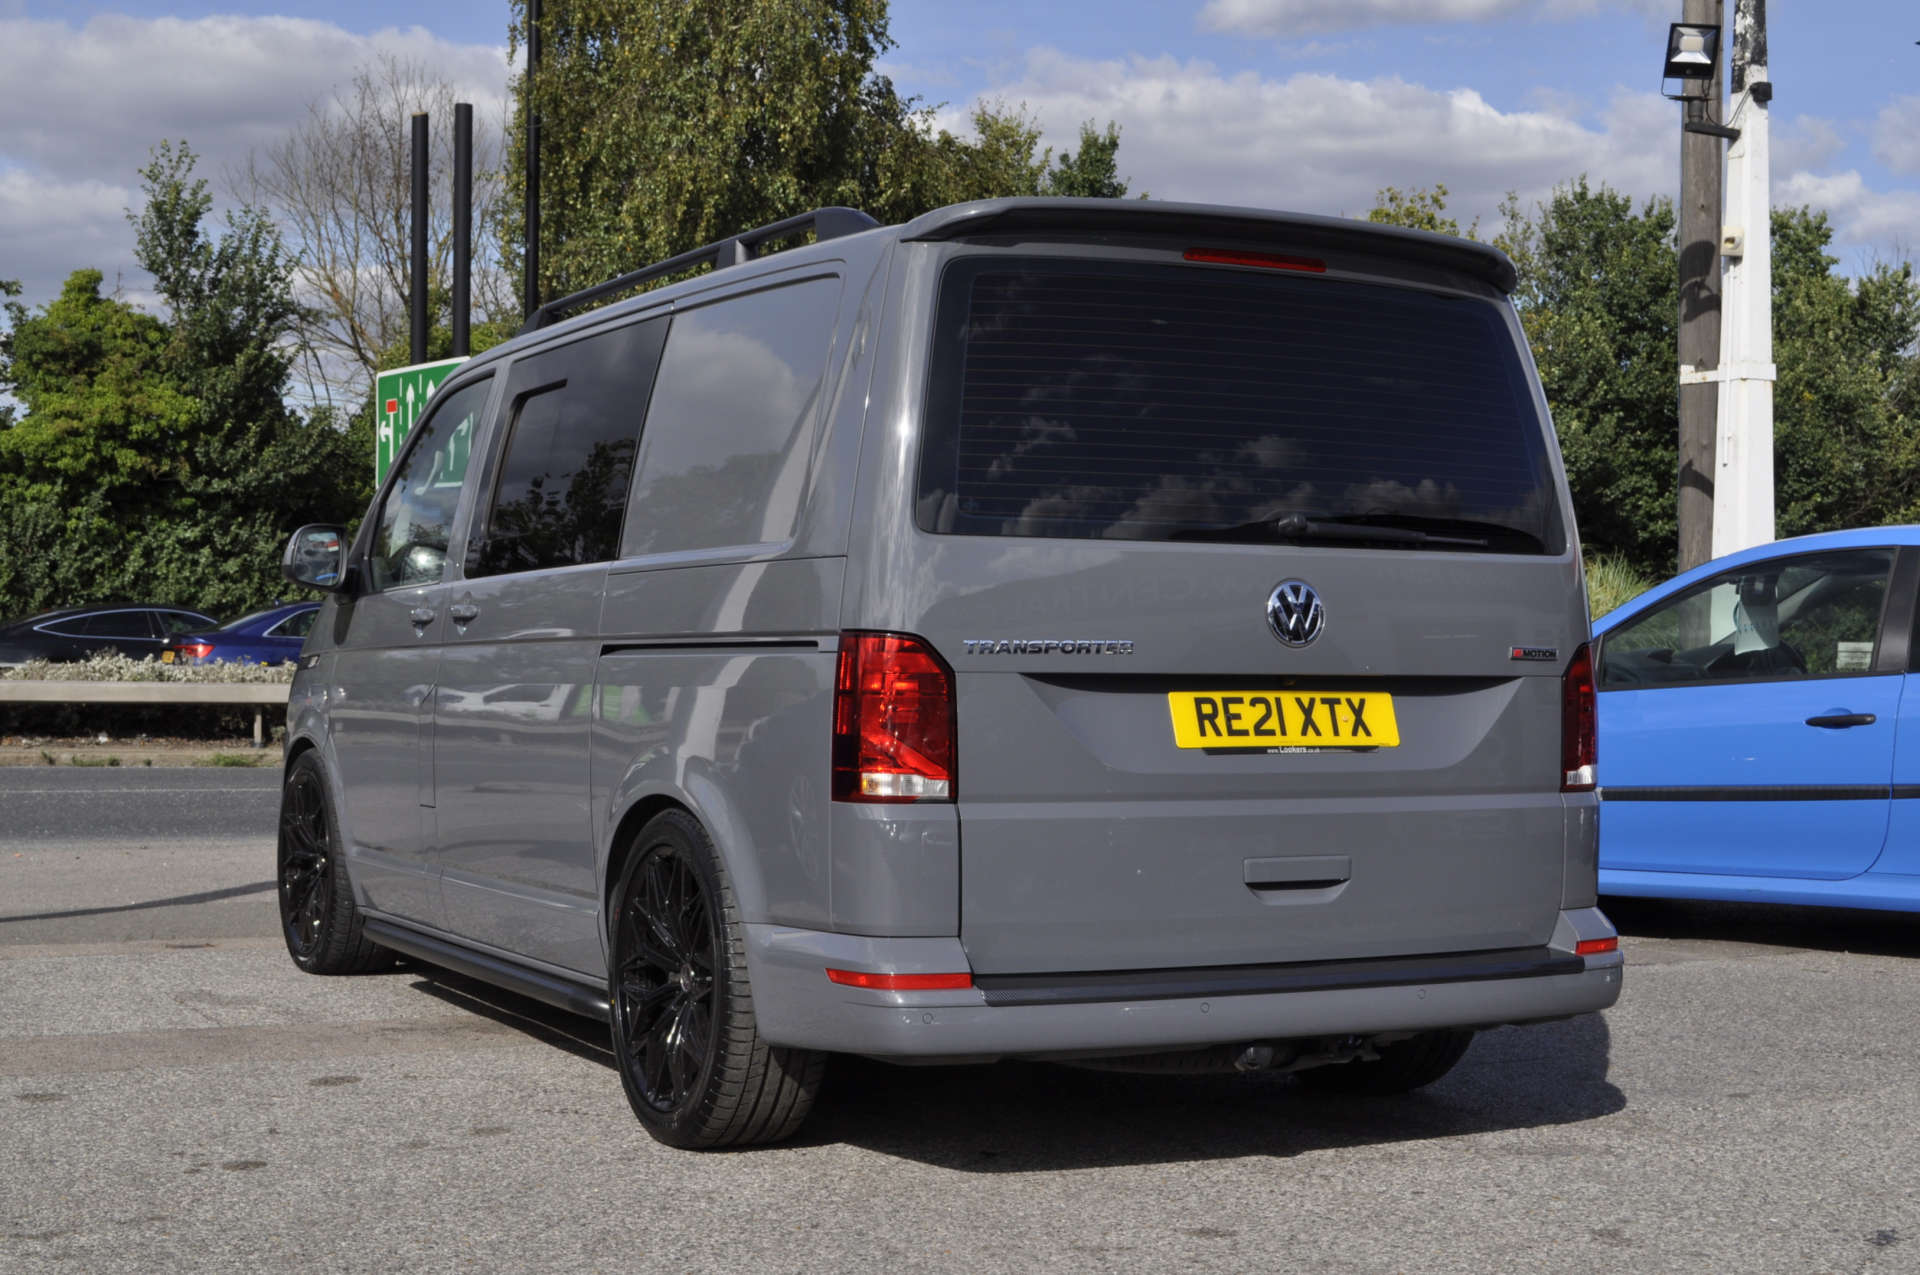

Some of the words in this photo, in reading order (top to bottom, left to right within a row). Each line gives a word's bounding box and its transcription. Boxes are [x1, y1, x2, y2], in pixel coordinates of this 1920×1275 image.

[1268, 582, 1322, 644] VW
[963, 639, 1134, 655] TRANSPORTER
[1194, 697, 1287, 737] RE21
[1295, 697, 1372, 737] XTX
